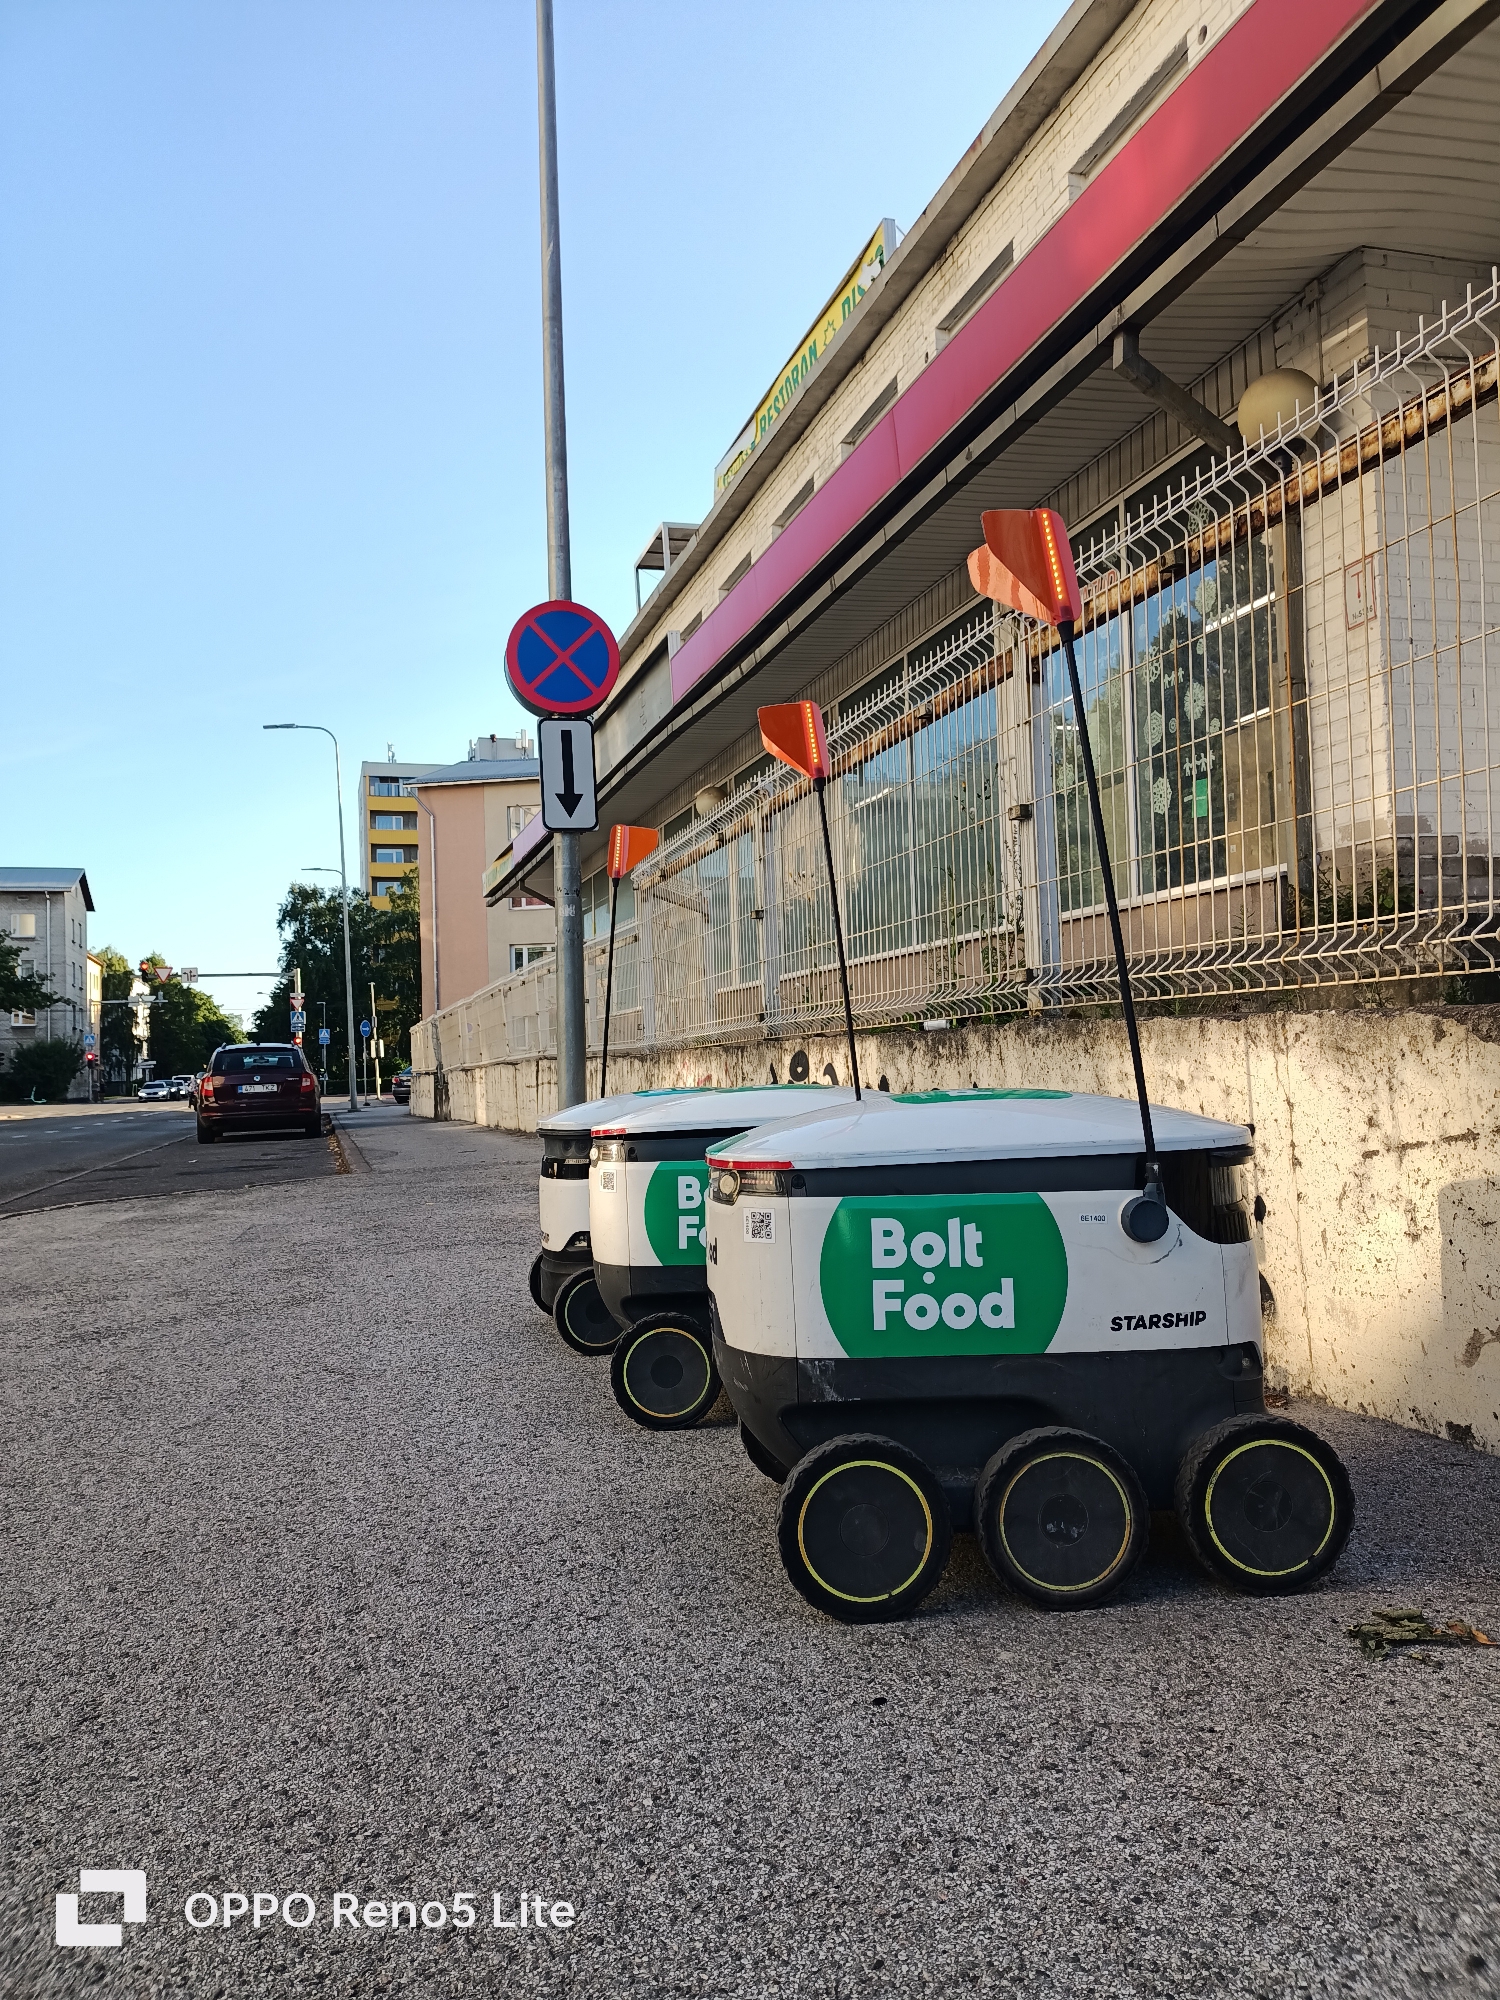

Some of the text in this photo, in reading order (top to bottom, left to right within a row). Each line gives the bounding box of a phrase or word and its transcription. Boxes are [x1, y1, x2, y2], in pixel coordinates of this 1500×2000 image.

[677, 1175, 708, 1210] B
[871, 1217, 983, 1268] Bolt
[872, 1277, 1015, 1330] Food
[1110, 1310, 1207, 1332] STARSHIP
